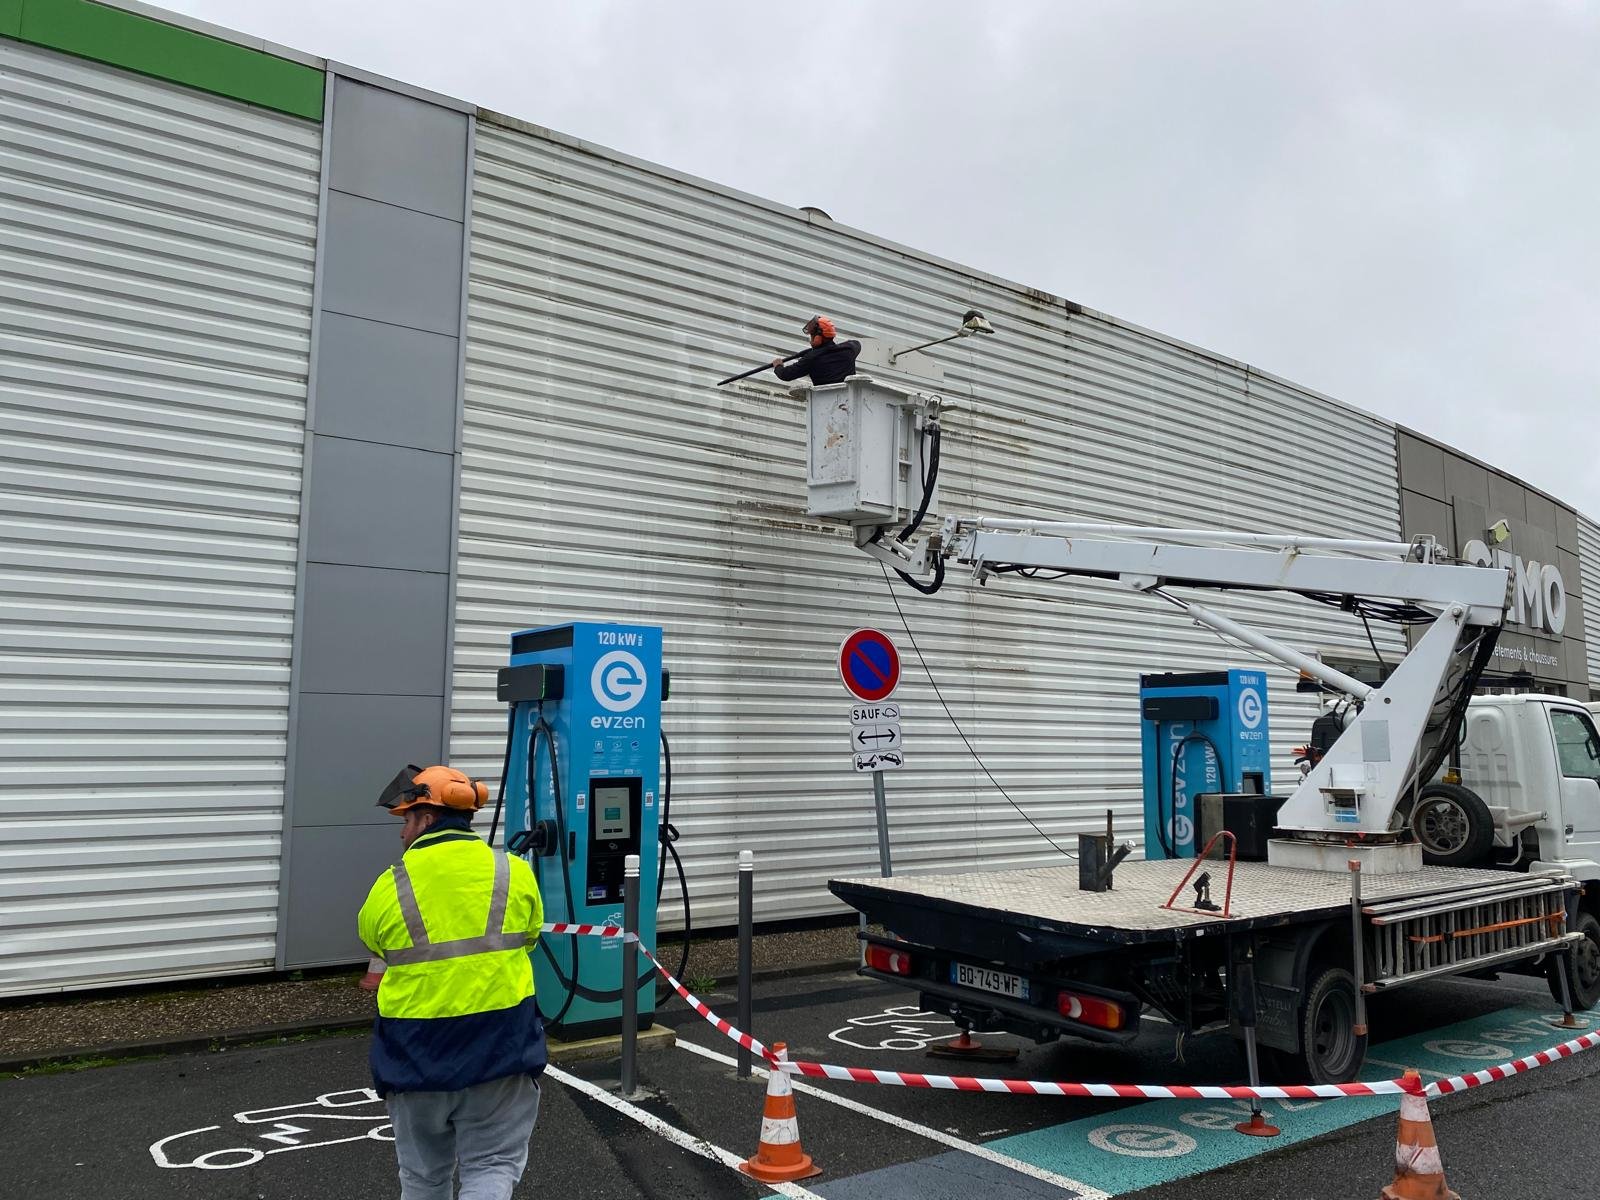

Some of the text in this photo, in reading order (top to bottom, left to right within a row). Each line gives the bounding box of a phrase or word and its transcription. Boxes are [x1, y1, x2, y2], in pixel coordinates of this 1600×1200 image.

[598, 631, 616, 645] 120
[618, 633, 637, 646] kW
[853, 708, 881, 720] SAUF
[590, 715, 645, 729] evzen
[1240, 731, 1263, 740] evzen
[1206, 767, 1217, 784] 120
[959, 965, 1019, 994] BQ-749-WF
